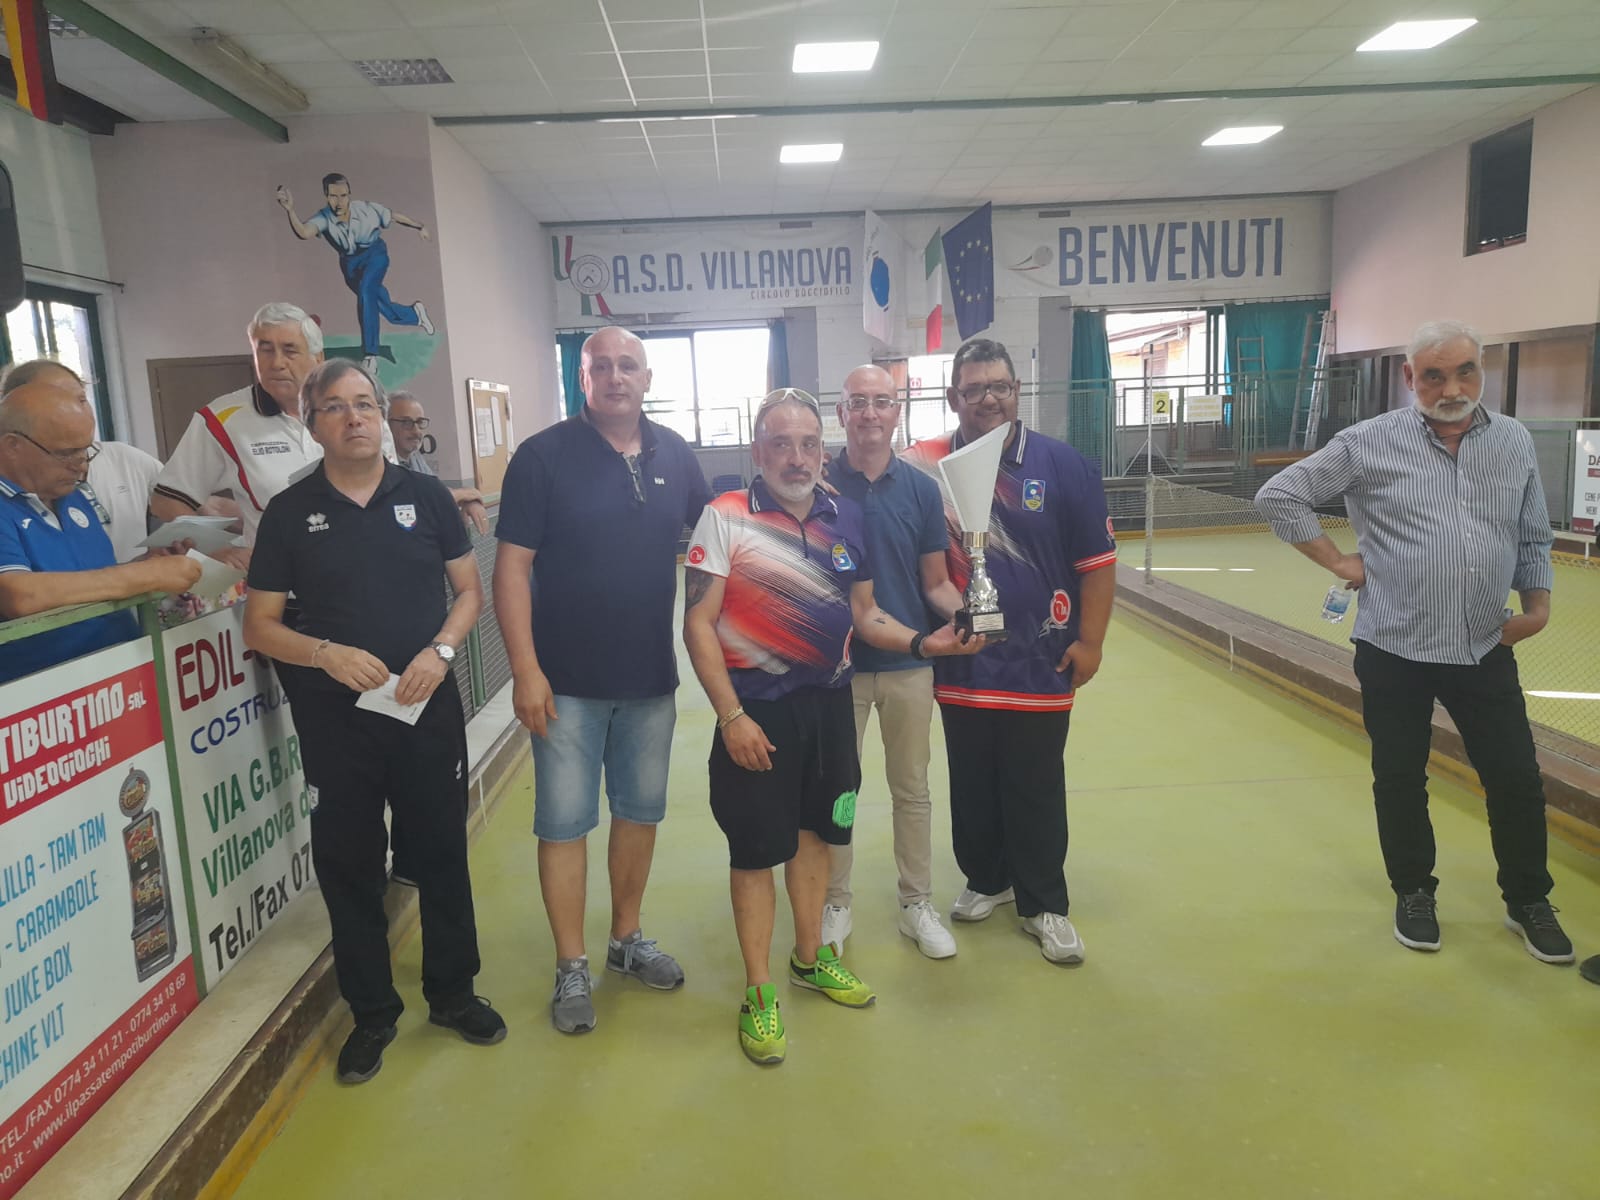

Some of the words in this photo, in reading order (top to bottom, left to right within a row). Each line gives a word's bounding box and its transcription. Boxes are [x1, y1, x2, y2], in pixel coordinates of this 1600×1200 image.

[612, 253, 693, 294] A.S.D.
[701, 247, 851, 290] VILLANOVA
[1059, 218, 1283, 286] BENVENUTI
[751, 289, 790, 300] CIRCOLO
[795, 286, 850, 298] BOCCIOFILO
[1156, 400, 1166, 414] 2
[128, 691, 147, 711] SRL
[202, 773, 246, 834] VIA
[48, 829, 78, 874] TAM
[79, 812, 106, 855] TAM
[201, 801, 295, 898] Villanova
[16, 869, 99, 953] CARAMBOLE
[209, 875, 289, 972] Tel./Fax
[291, 842, 310, 892] 07
[5, 965, 41, 1024] JUKE
[43, 942, 73, 991] BOX
[41, 1002, 64, 1049] VLT
[0, 1094, 53, 1155] TEL./FAX
[54, 1069, 81, 1103] 0774
[82, 1056, 96, 1077] 34
[98, 1042, 110, 1061] 11
[111, 1030, 123, 1051] 21
[130, 1003, 152, 1032] 0774
[152, 993, 164, 1011] 34
[165, 982, 175, 999] 18
[175, 973, 186, 990] 69
[32, 1003, 177, 1150] www.ilpassatempotiburtino.it
